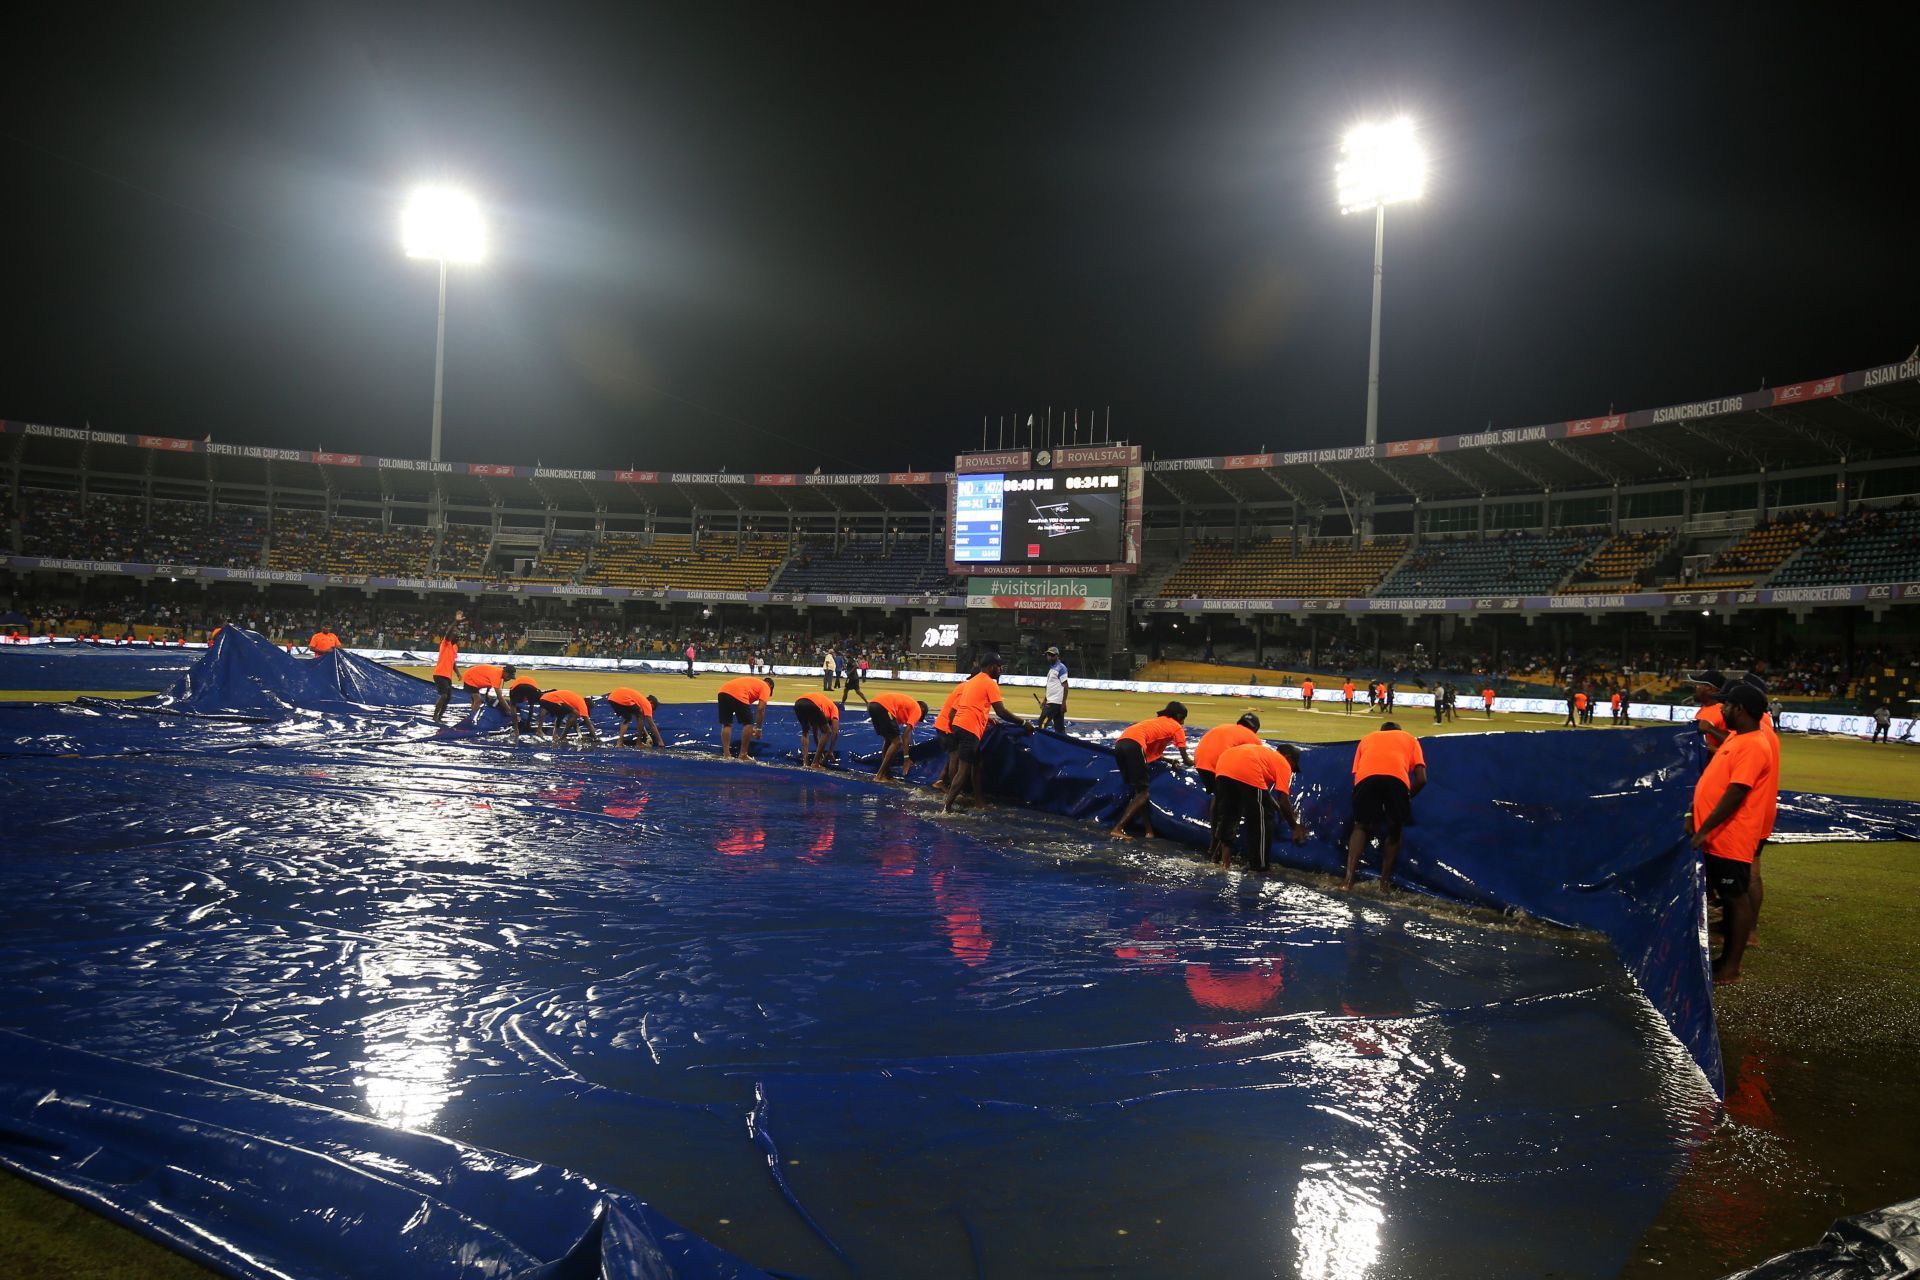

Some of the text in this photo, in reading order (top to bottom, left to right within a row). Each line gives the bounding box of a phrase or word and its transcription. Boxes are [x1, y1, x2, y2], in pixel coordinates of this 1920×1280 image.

[1864, 365, 1897, 387] ASIAN
[1652, 395, 1743, 424] ASIANCRICKET.ORG
[25, 424, 128, 445] ASIAN CRICKET COUNCIL
[1458, 427, 1546, 448] COLOMBO, SRI LANKA
[244, 448, 262, 458] ASIA
[263, 449, 278, 459] CUP
[279, 451, 300, 461] 2023
[1319, 450, 1336, 462] ASIA
[1338, 449, 1353, 460] CUP
[1354, 446, 1375, 458] 2023
[379, 458, 452, 472] COLOMBO, SRI LANKA
[1154, 461, 1183, 472] CRICKET
[1184, 459, 1214, 470] COUNCIL
[534, 468, 596, 480] ASIANCRICKET.ORG
[672, 473, 746, 484] ASIAN CRICKET COUNCIL
[834, 475, 849, 484] ASIA
[850, 475, 862, 484] CUP
[863, 474, 880, 484] 2023
[39, 559, 123, 572] ASIAN CRICKET COUNCIL
[256, 570, 271, 580] ASIA
[272, 572, 285, 580] CUP
[285, 572, 302, 582] 2023
[397, 579, 427, 589] COLOMBO,
[438, 581, 458, 590] LANKA
[991, 580, 1088, 596] #visitsrilanka
[552, 586, 603, 596] ASIANCRICKET.ORG
[687, 591, 748, 601] ASIAN CRICKET COUNCIL
[1772, 587, 1852, 602] ASIANCRICKET.ORG
[1868, 586, 1890, 597] ACC
[849, 596, 861, 604] ASIA
[862, 596, 872, 604] CUP
[873, 596, 886, 604] 2023
[1014, 601, 1062, 610] #ASIACUP2023
[1203, 600, 1274, 610] ASIAN CRICKET COUNCIL
[1398, 600, 1413, 610] ASIA
[1414, 600, 1428, 610] CUP
[1428, 599, 1446, 609] 2023
[1550, 596, 1625, 608] COLOMBO, SRI LANKA
